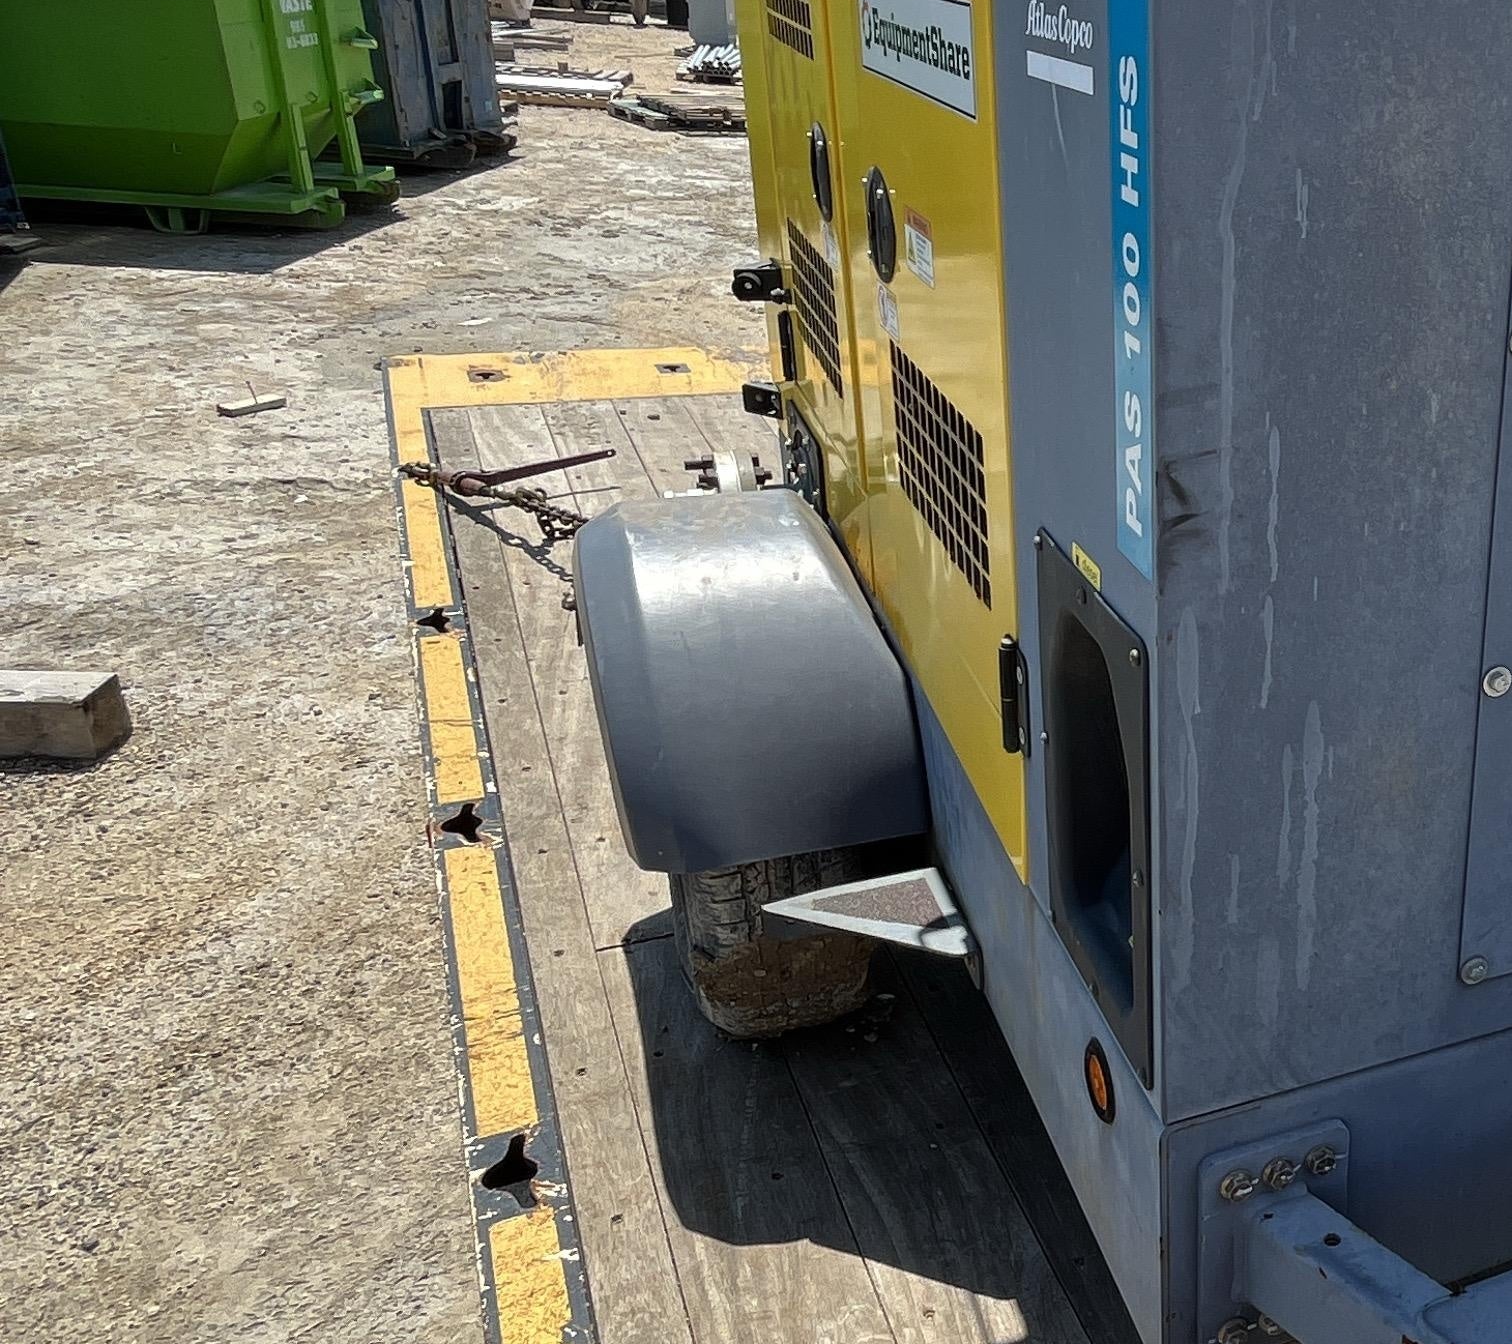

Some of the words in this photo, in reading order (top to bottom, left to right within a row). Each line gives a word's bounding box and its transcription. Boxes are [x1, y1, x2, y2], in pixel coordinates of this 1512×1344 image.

[872, 7, 970, 80] EquipmentShare
[1025, 0, 1058, 41] Atlas
[1058, 4, 1093, 54] Copco
[1118, 54, 1141, 208] HFS
[1120, 231, 1143, 362] 100
[1123, 389, 1144, 539] PAS
